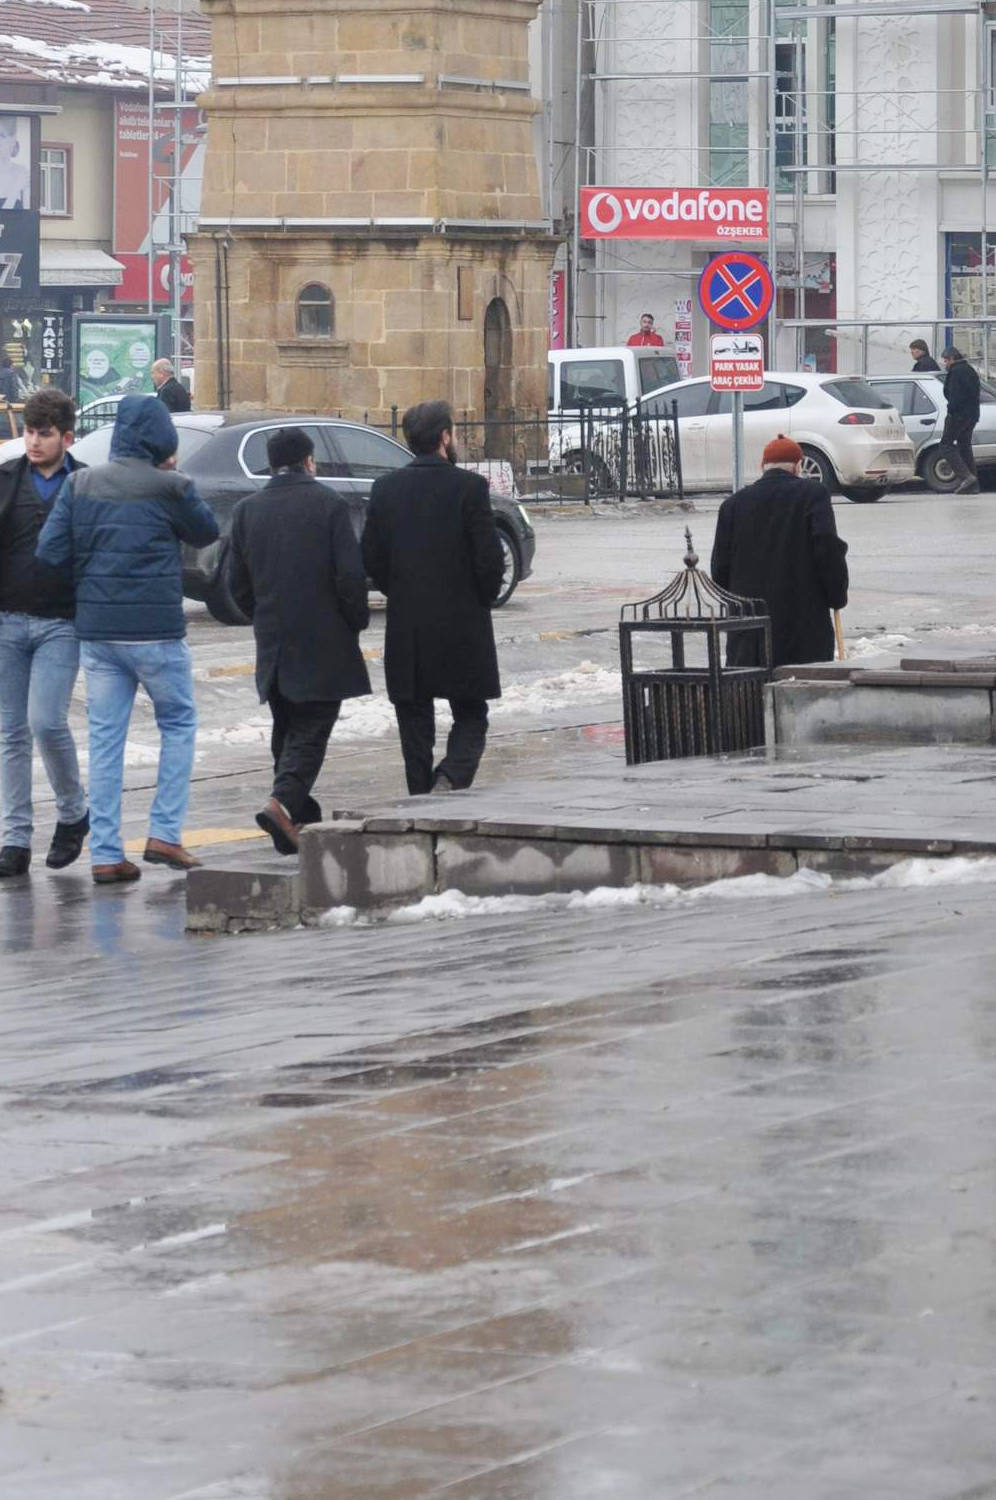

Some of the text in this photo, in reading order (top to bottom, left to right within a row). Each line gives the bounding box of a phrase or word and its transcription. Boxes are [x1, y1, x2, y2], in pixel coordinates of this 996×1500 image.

[625, 191, 763, 221] vodafone
[717, 226, 763, 237] ÖZŞEKER
[715, 361, 760, 371] PARK YASAK
[713, 375, 762, 387] ARAÇ ÇEKİLİR
